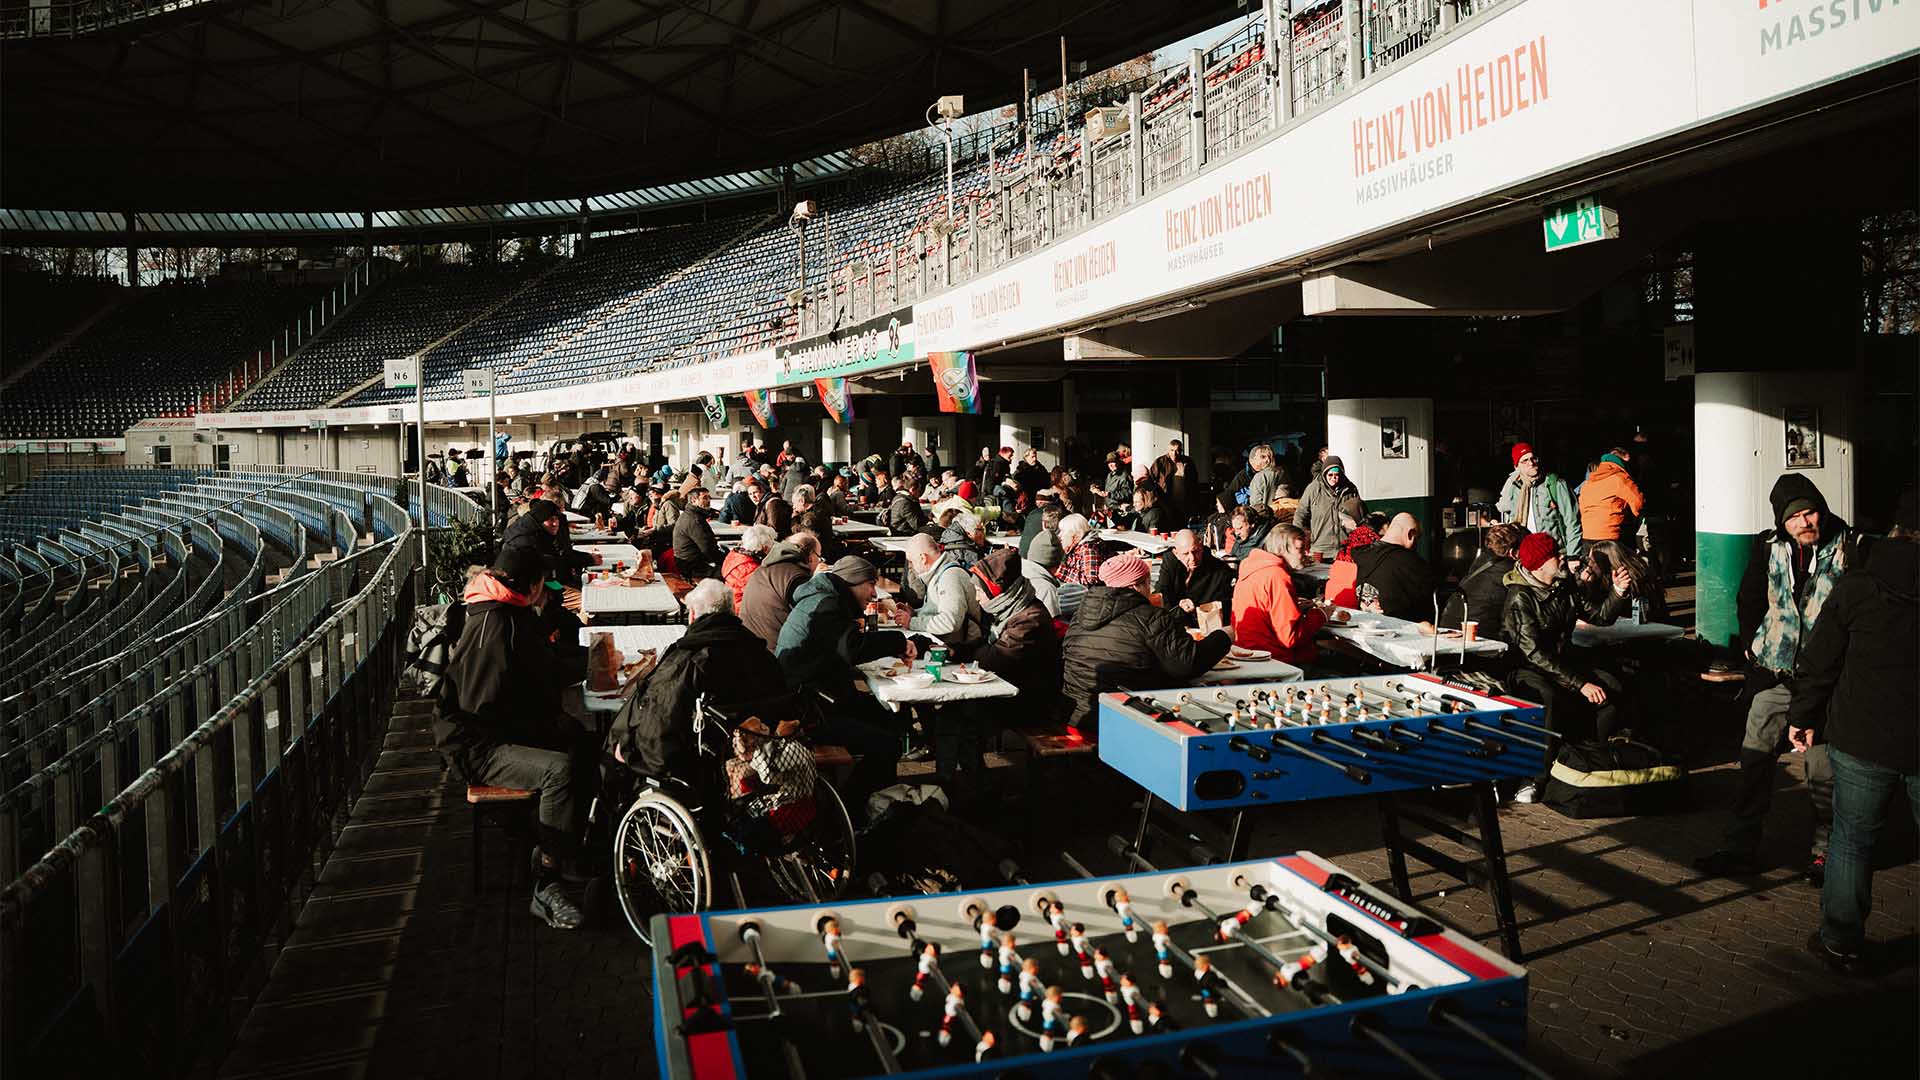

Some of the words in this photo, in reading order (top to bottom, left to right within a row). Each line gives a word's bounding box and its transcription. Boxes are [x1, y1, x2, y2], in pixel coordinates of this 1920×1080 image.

[1761, 0, 1902, 56] MASSI
[1353, 105, 1407, 178] HEINZ
[1410, 82, 1453, 153] VON
[1457, 35, 1549, 134] HEIDEN
[1356, 153, 1454, 205] MASSIVHÄUSER
[1166, 205, 1197, 252] HEINZ
[1200, 194, 1222, 240] VON
[1225, 171, 1272, 231] HEIDEN
[799, 334, 861, 374] HANNOVER
[863, 328, 878, 361] 96
